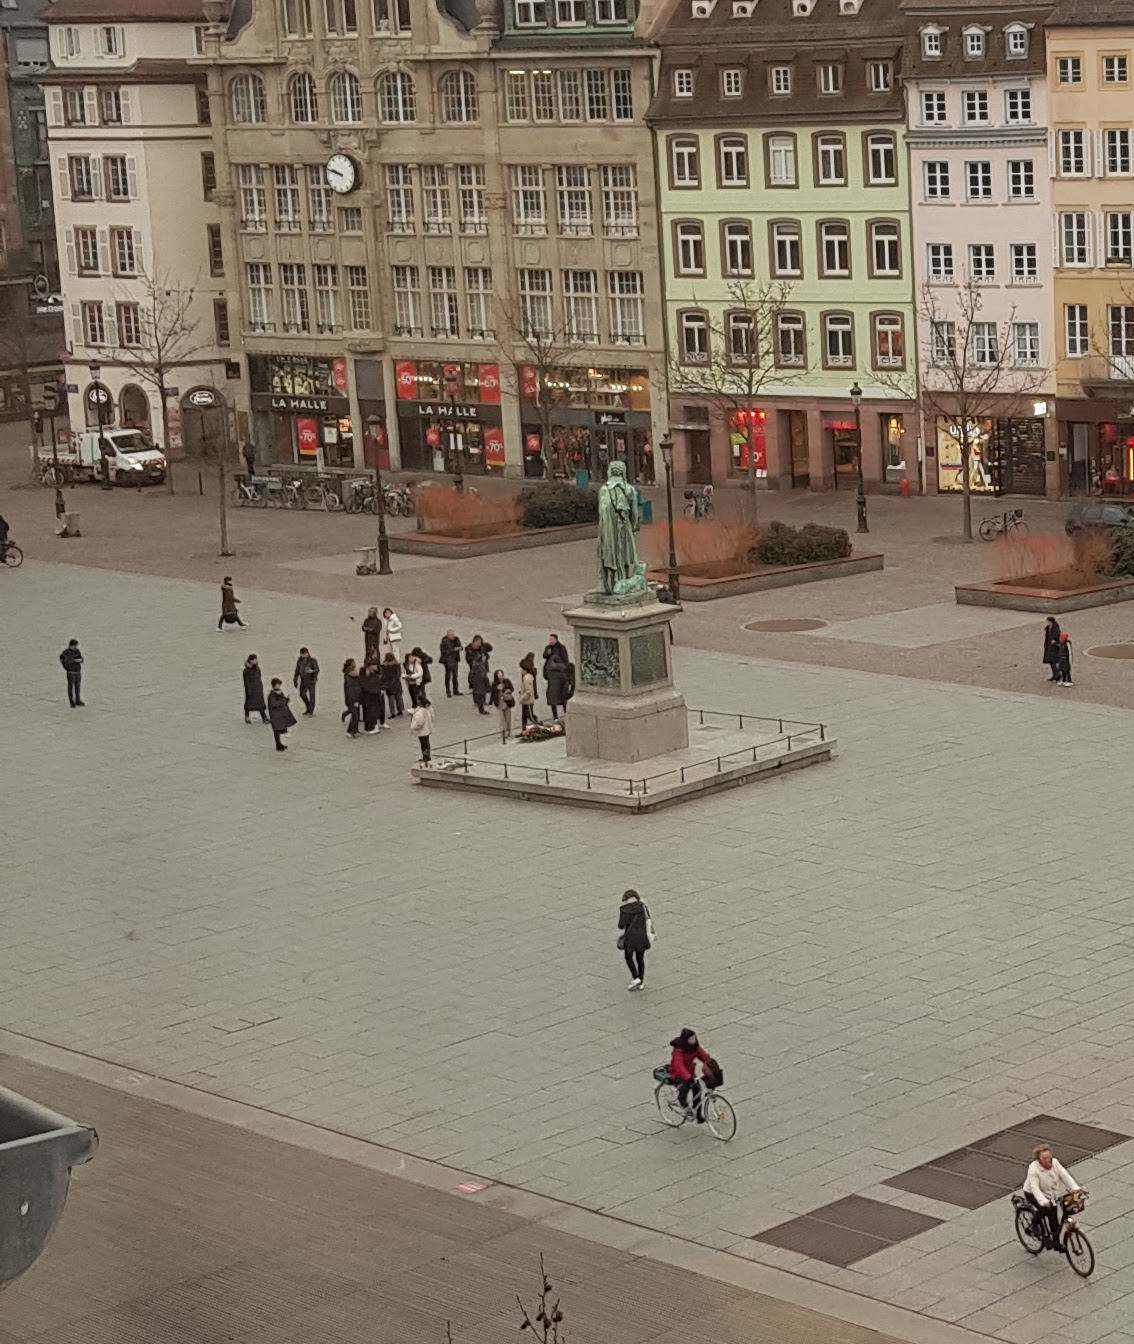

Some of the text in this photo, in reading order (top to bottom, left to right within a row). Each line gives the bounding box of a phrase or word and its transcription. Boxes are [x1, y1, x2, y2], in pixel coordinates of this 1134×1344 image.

[271, 398, 328, 410] LA HALLE
[418, 405, 434, 414] LA
